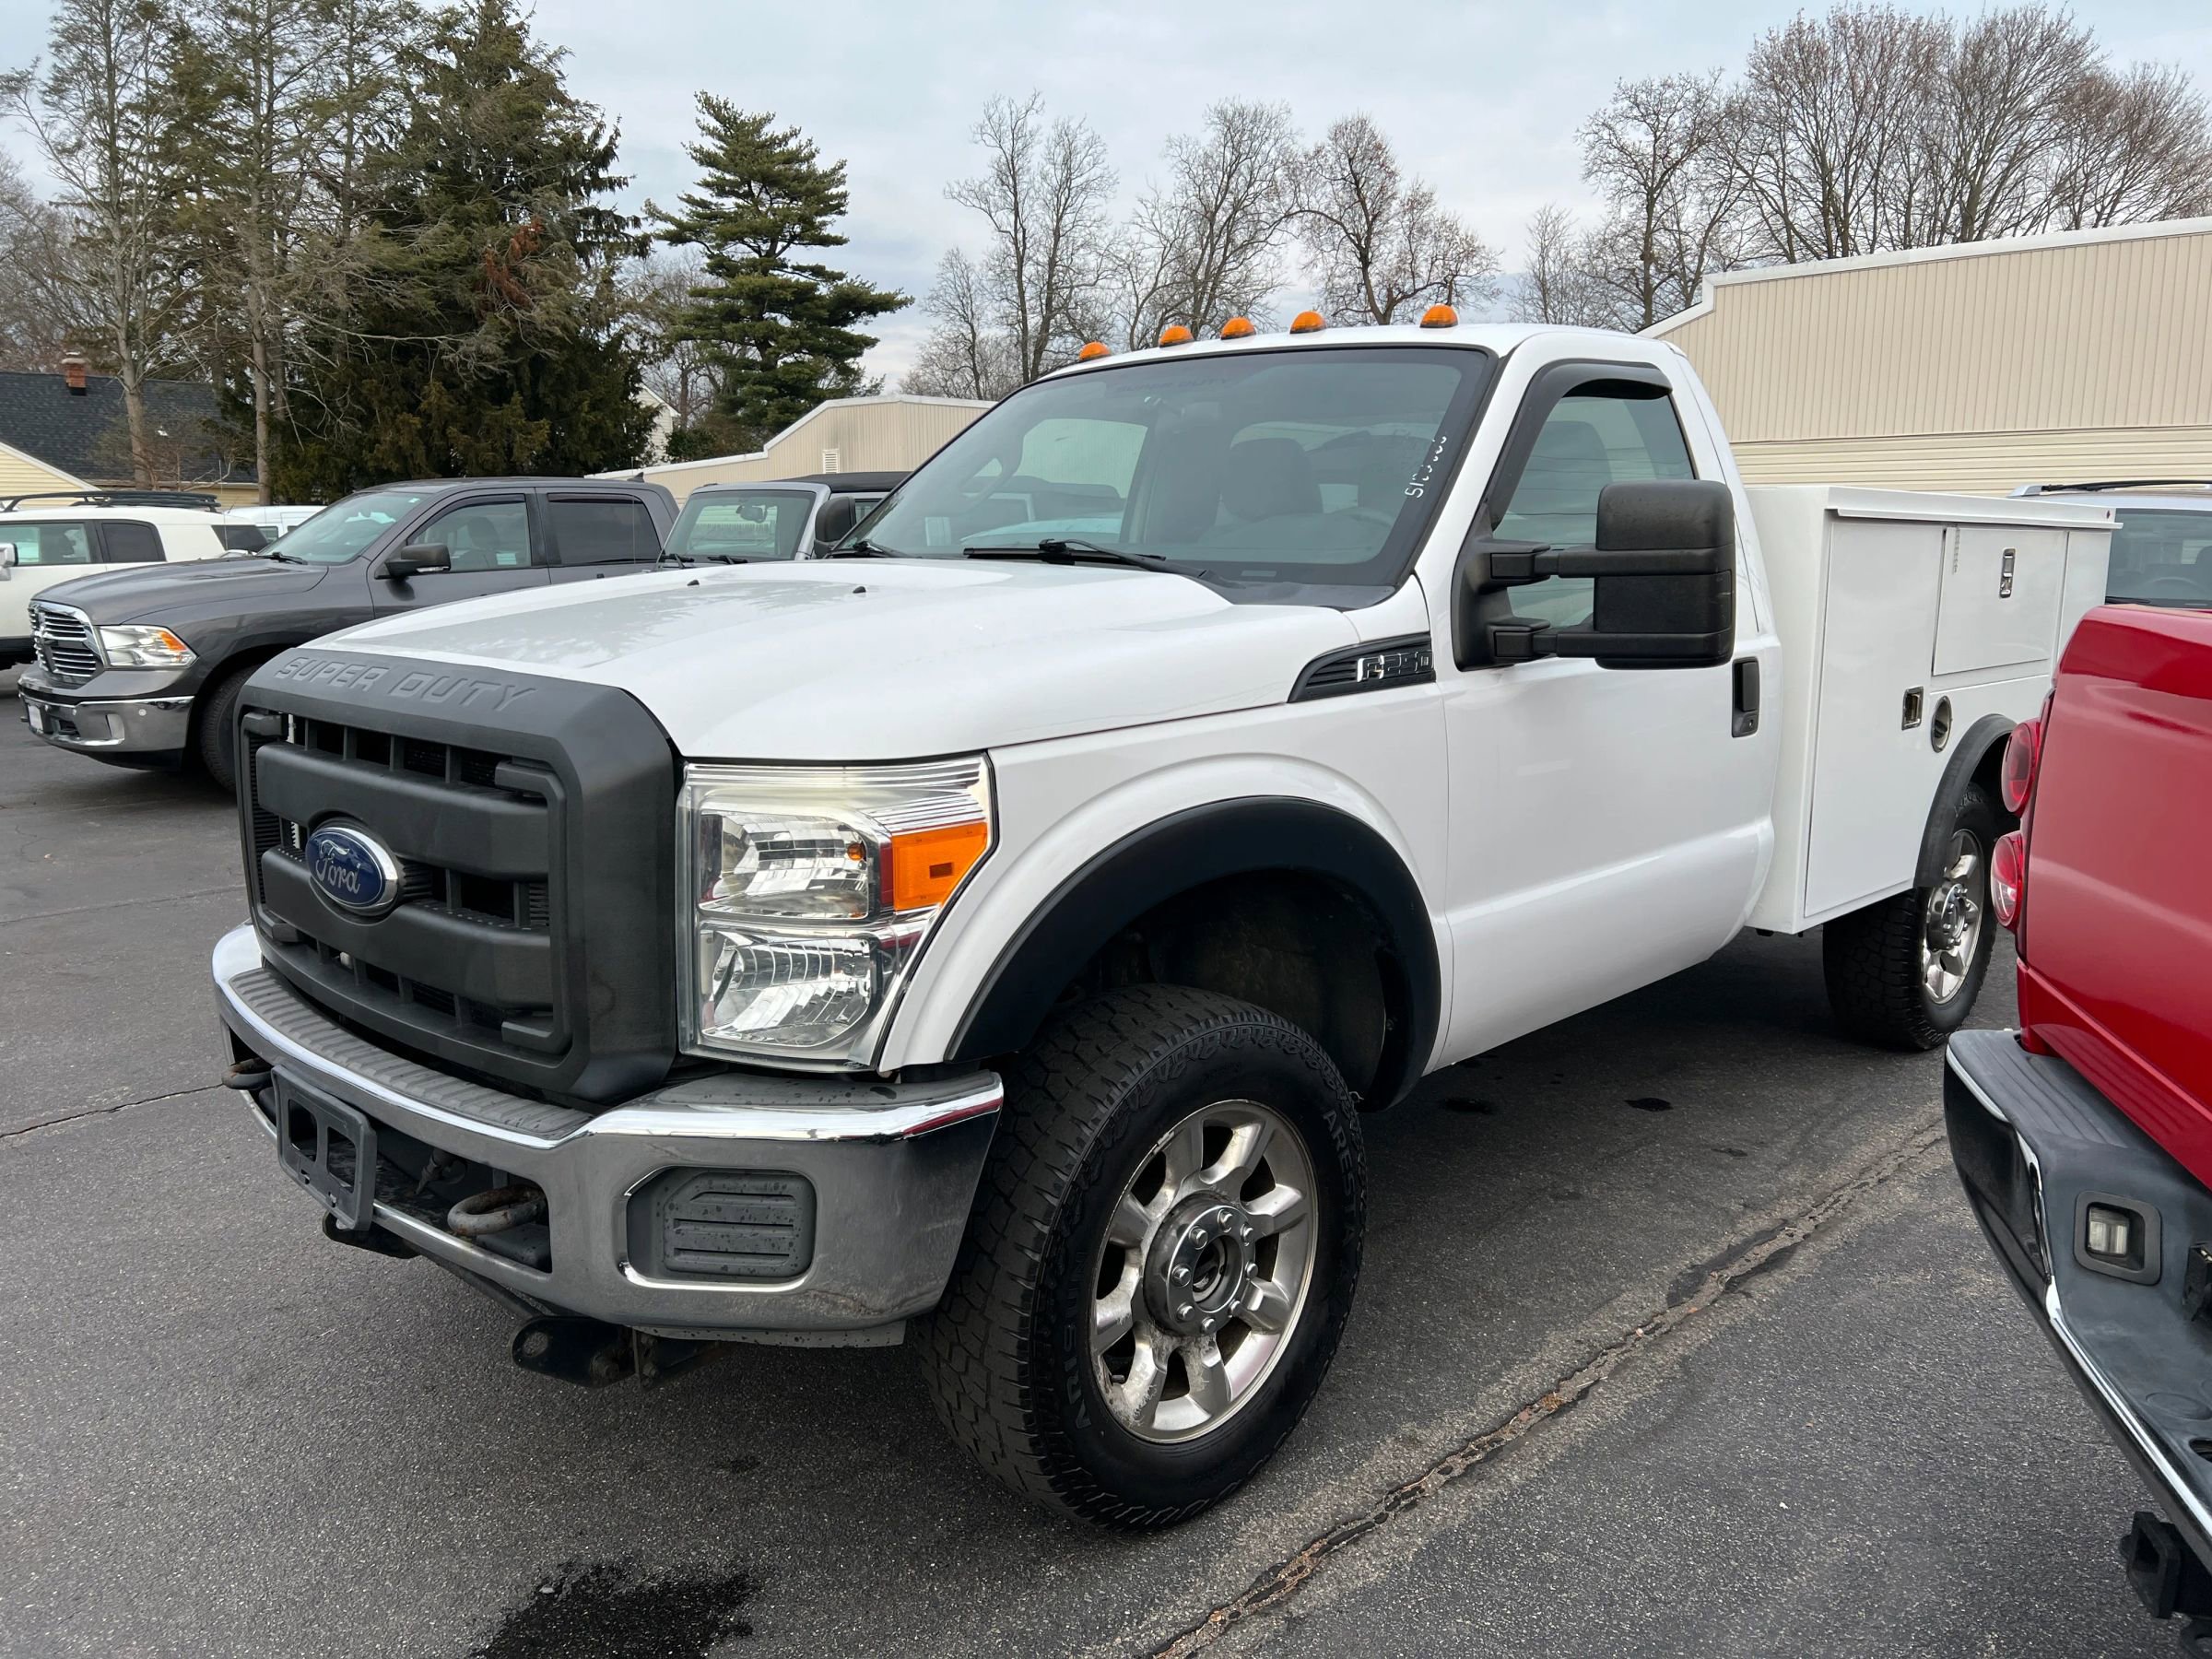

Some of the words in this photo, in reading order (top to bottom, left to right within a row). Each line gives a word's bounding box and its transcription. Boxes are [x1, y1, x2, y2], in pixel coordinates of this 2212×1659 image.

[274, 656, 391, 692] SUPER
[386, 671, 537, 712] DUTY
[315, 840, 361, 894] Ford
[1322, 1109, 1357, 1248] ARESTA
[1063, 1251, 1094, 1429] ARISUN
